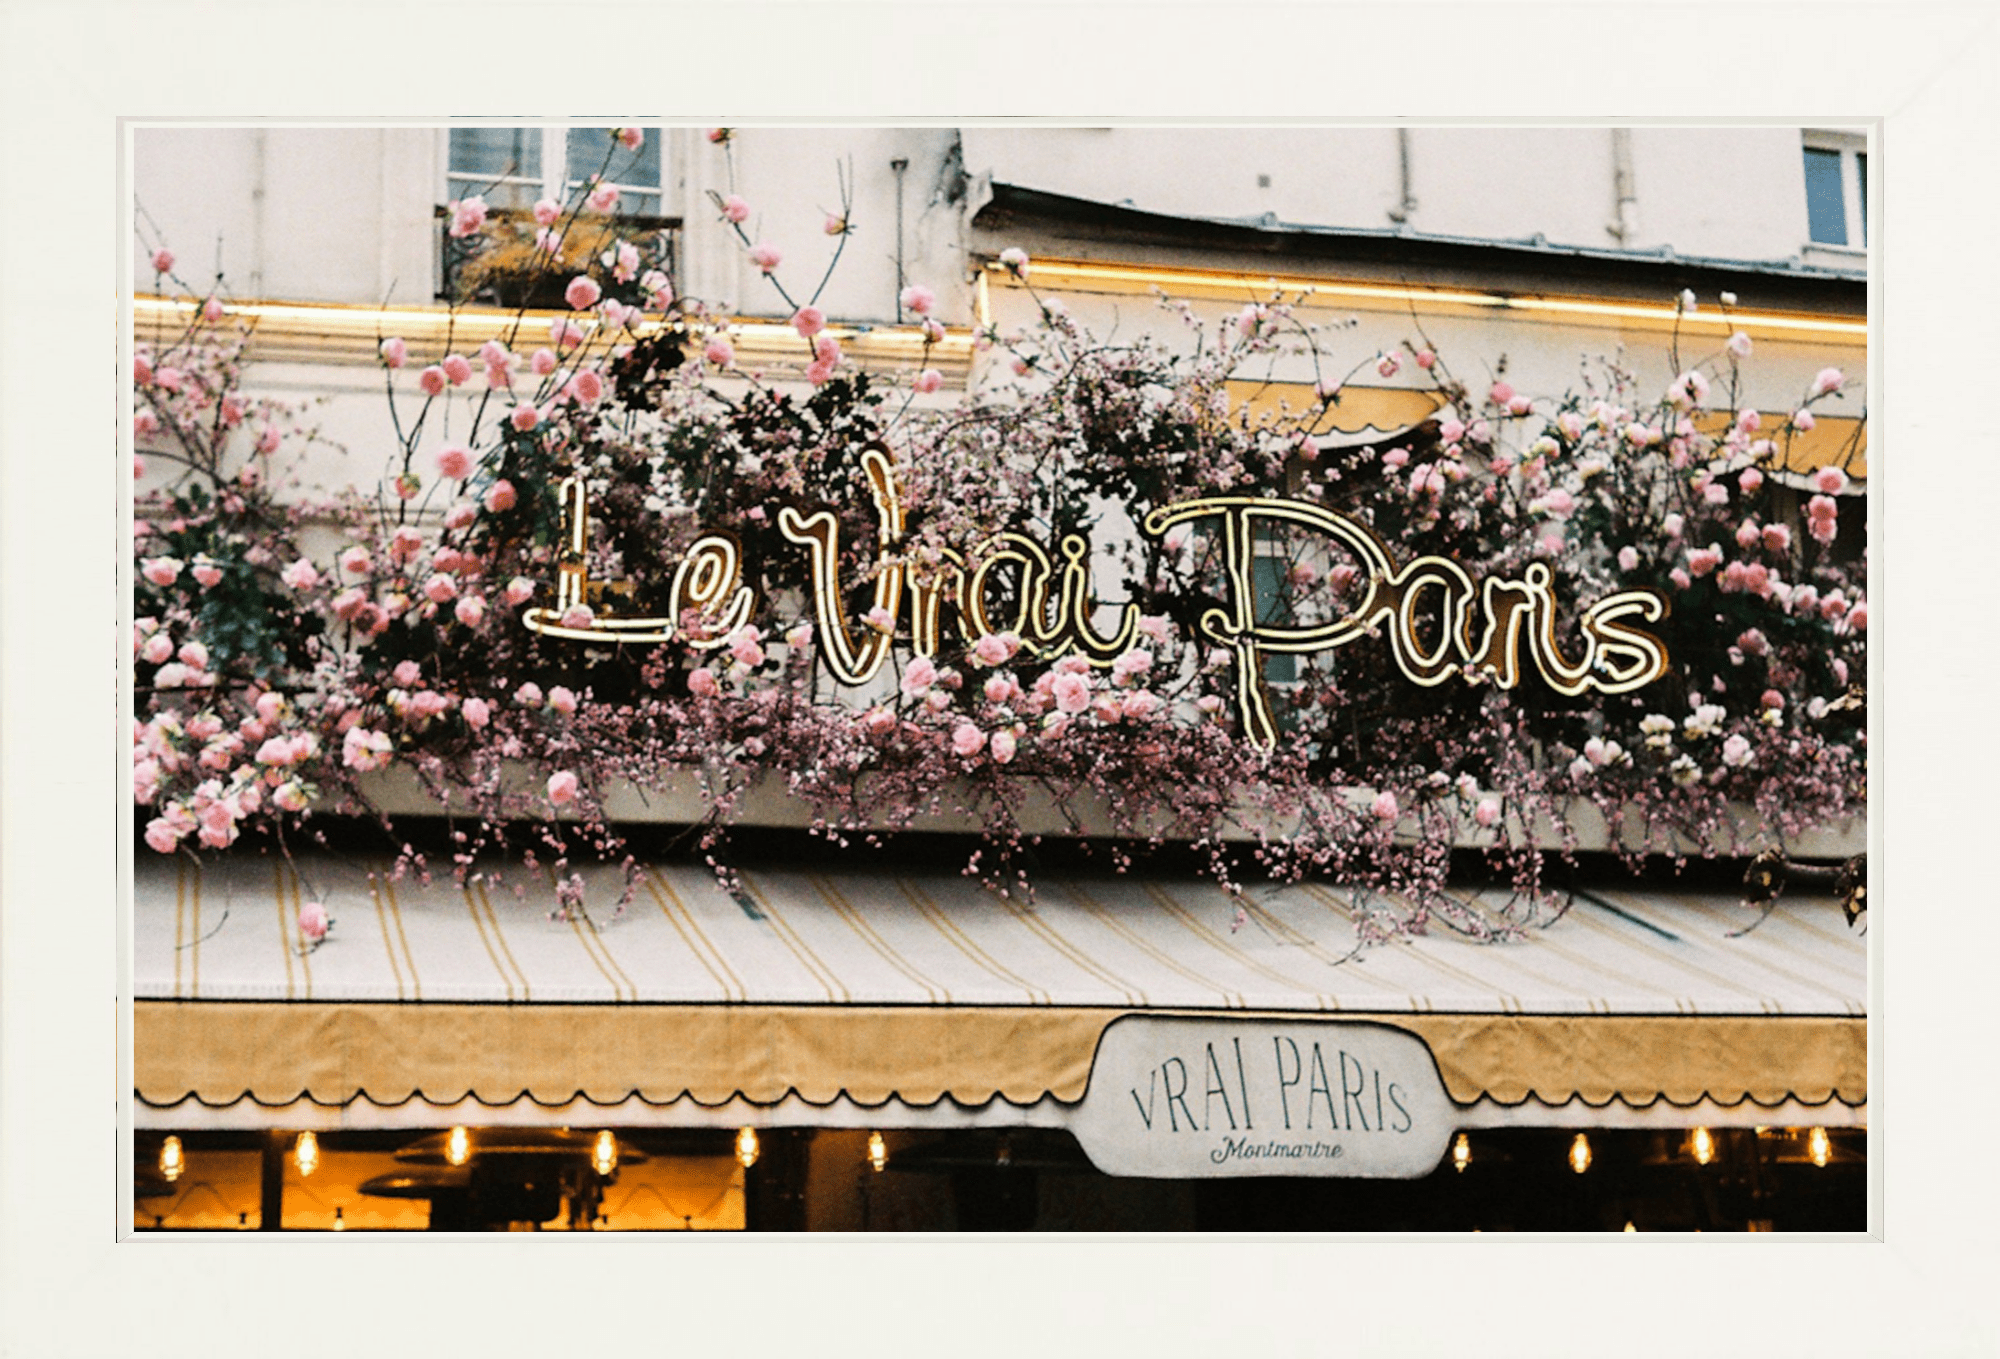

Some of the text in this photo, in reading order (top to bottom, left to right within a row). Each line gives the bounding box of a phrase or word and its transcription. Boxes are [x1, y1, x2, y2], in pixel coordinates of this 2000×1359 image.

[522, 448, 1664, 753] Le Vrai Paris
[1130, 1035, 1413, 1134] VRAI PARIS
[1210, 1135, 1344, 1165] Montmartre
